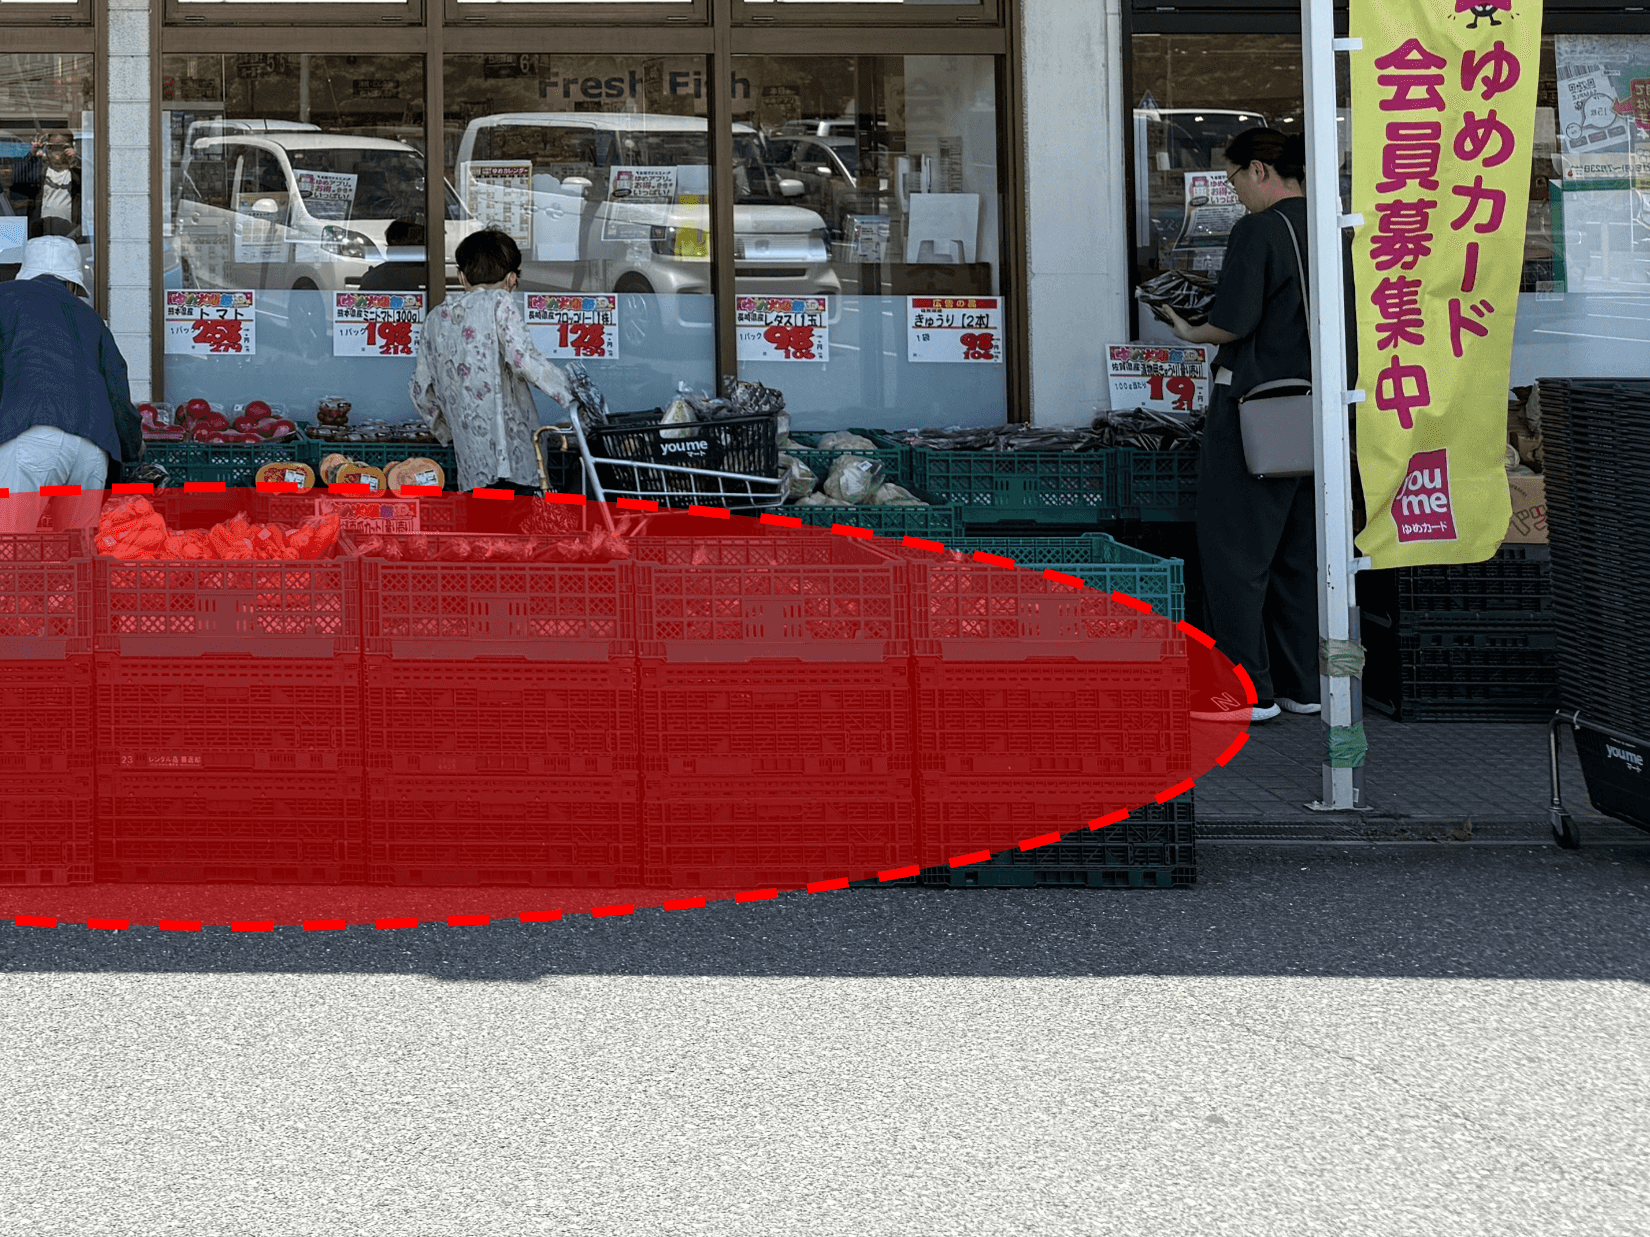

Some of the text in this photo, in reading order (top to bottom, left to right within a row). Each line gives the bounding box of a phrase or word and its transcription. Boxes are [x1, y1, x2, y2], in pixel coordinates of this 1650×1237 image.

[1448, 40, 1521, 358] ゆめカード
[1370, 38, 1447, 429] 会員募集中
[200, 308, 244, 320] トマト
[914, 314, 954, 327] きゅうり
[1147, 376, 1195, 400] 19
[688, 449, 706, 458] マート
[1402, 493, 1448, 516] me
[1402, 522, 1448, 535] ゆめカード
